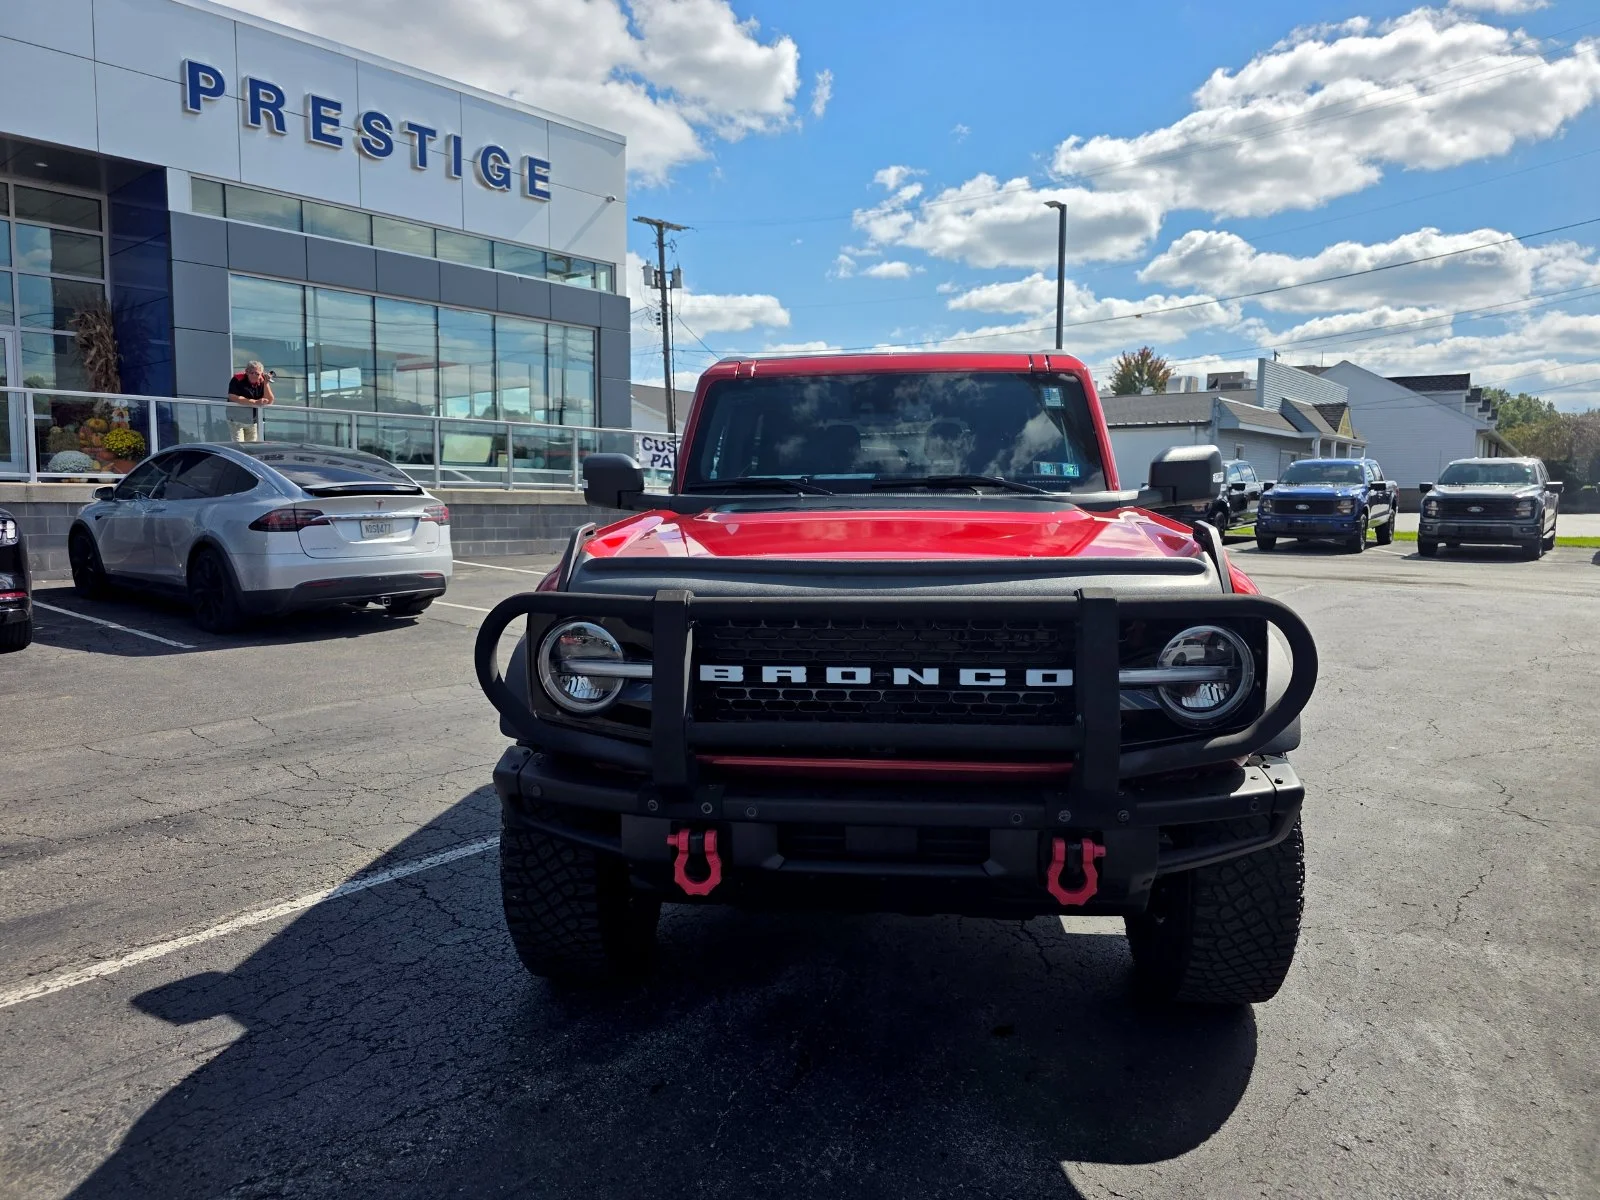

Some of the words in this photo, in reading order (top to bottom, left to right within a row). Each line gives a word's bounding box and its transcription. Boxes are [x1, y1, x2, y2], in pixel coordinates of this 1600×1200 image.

[182, 58, 552, 201] PRESTIGE
[642, 436, 681, 454] CUS
[699, 665, 1074, 687] BRONCO
